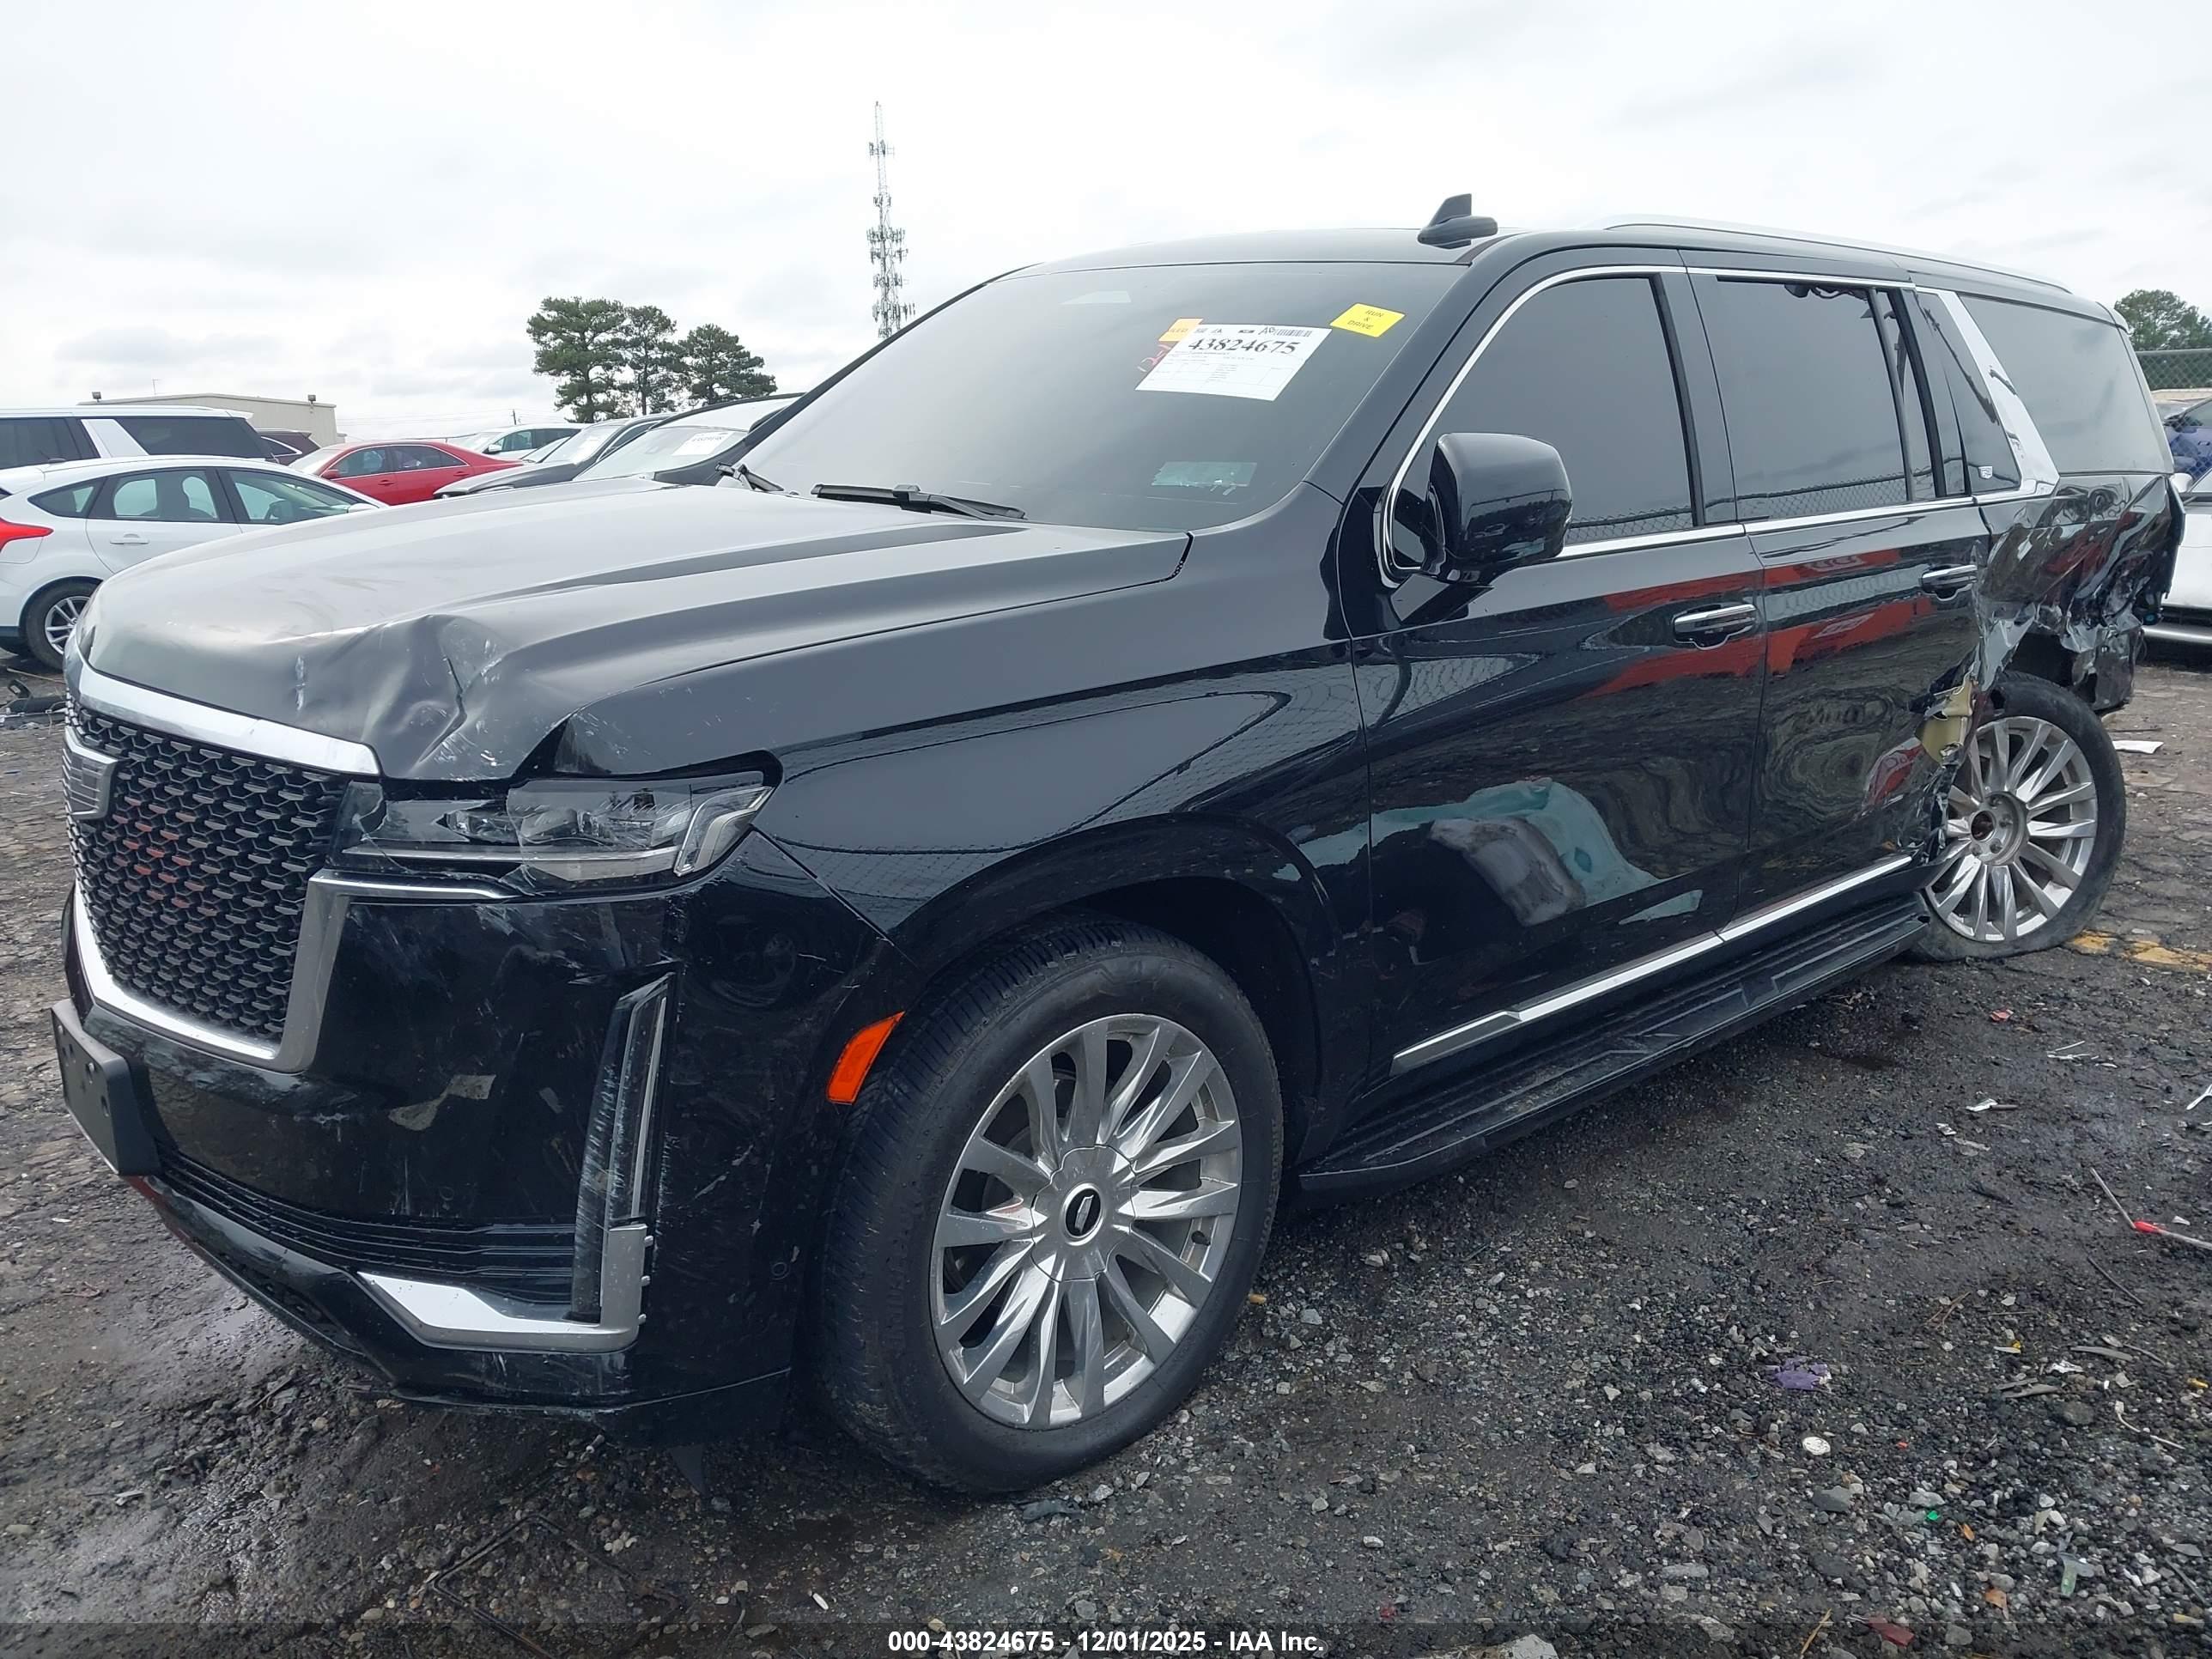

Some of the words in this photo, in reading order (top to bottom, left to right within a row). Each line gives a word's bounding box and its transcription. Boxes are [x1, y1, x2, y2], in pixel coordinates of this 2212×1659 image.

[1364, 309, 1385, 318] RUN
[1346, 319, 1375, 330] DRIVE
[1188, 337, 1302, 355] 43824675
